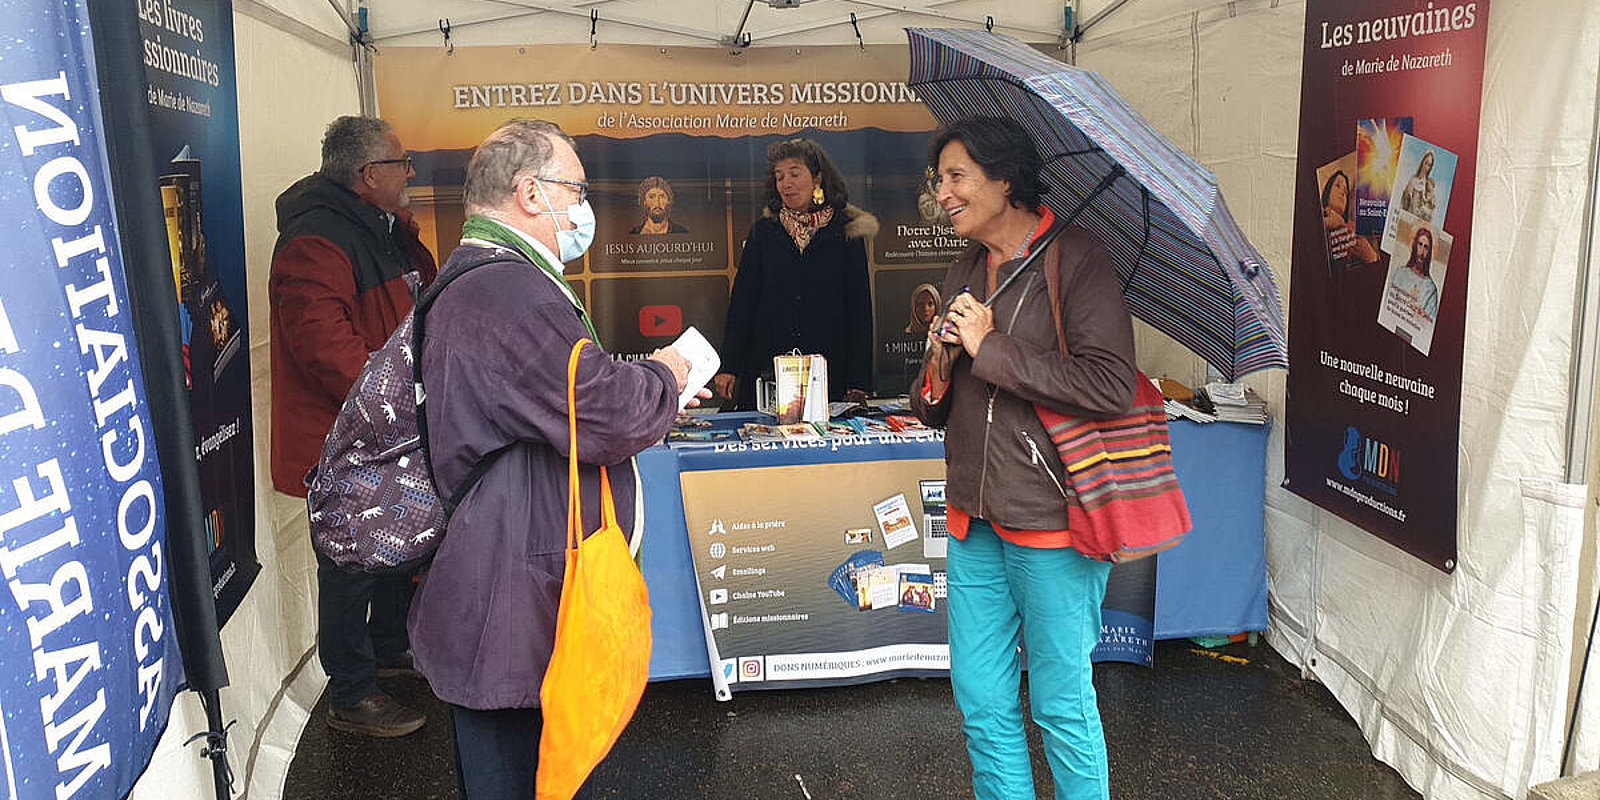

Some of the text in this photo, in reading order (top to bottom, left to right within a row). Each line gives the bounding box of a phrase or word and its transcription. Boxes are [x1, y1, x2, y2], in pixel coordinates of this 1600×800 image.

[138, 0, 204, 43] Les livres
[1321, 2, 1476, 49] Les neuvaines
[143, 34, 219, 87] ssionnaires
[1342, 48, 1452, 76] de Marie de Nazareth
[147, 84, 157, 105] de
[453, 81, 921, 109] ENTREZ DANS L'UNIVERS MISSIONN
[598, 111, 848, 129] de l'Association Marie de Nazareth
[931, 223, 955, 237] Hist
[605, 243, 635, 255] JESUS
[907, 236, 969, 249] avec Marie
[892, 341, 925, 353] MINUT
[1320, 351, 1435, 399] Une nouvelle neuvaine
[1339, 379, 1376, 404] chaque
[1377, 391, 1404, 413] mois
[1364, 437, 1400, 482] MDN
[731, 543, 776, 554] Services web
[774, 663, 800, 672] DONS
